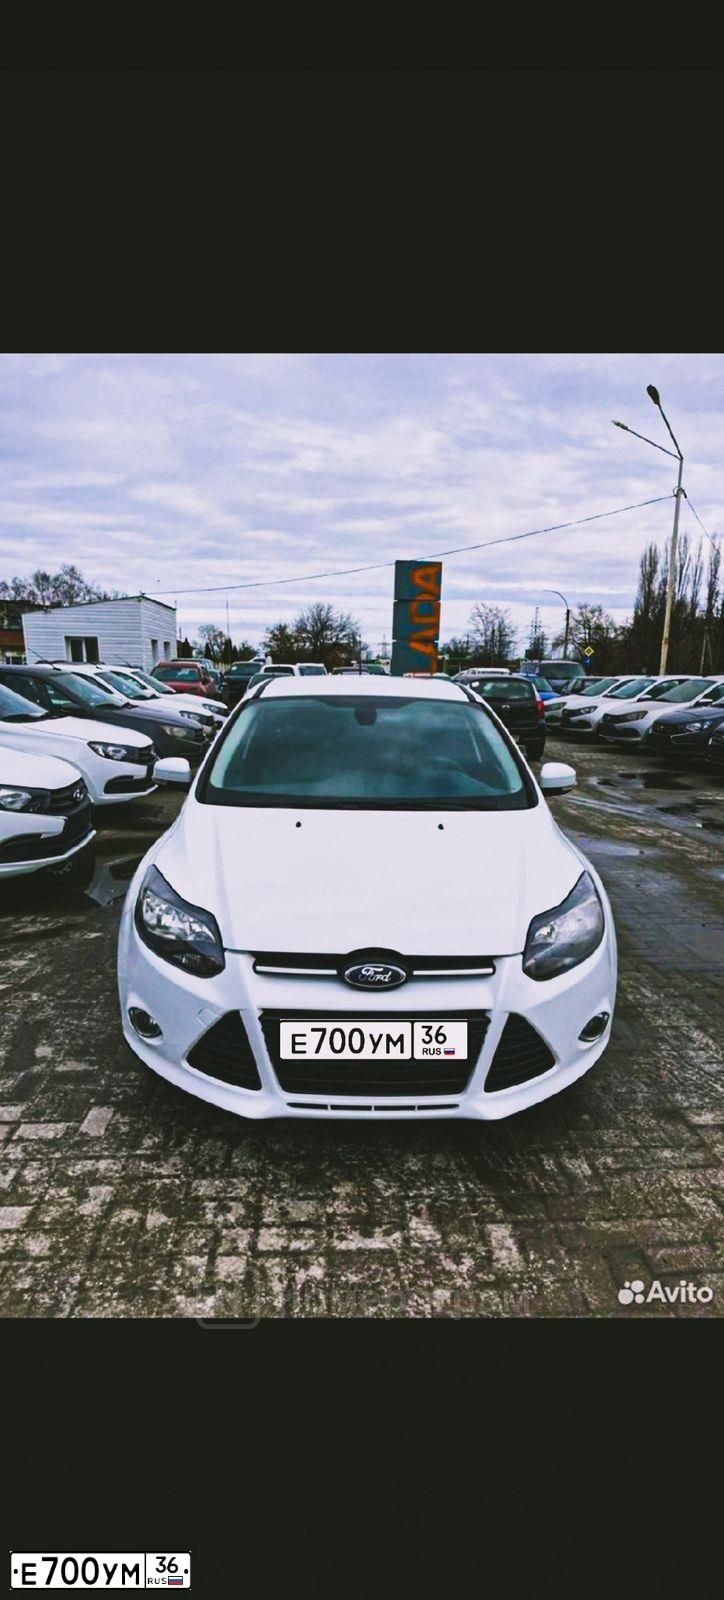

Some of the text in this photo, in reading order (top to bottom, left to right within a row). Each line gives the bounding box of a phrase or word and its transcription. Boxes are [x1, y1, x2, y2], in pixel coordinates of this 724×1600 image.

[358, 966, 393, 983] Ford
[291, 1025, 447, 1055] Е700УМ 36
[422, 1047, 442, 1056] RUS
